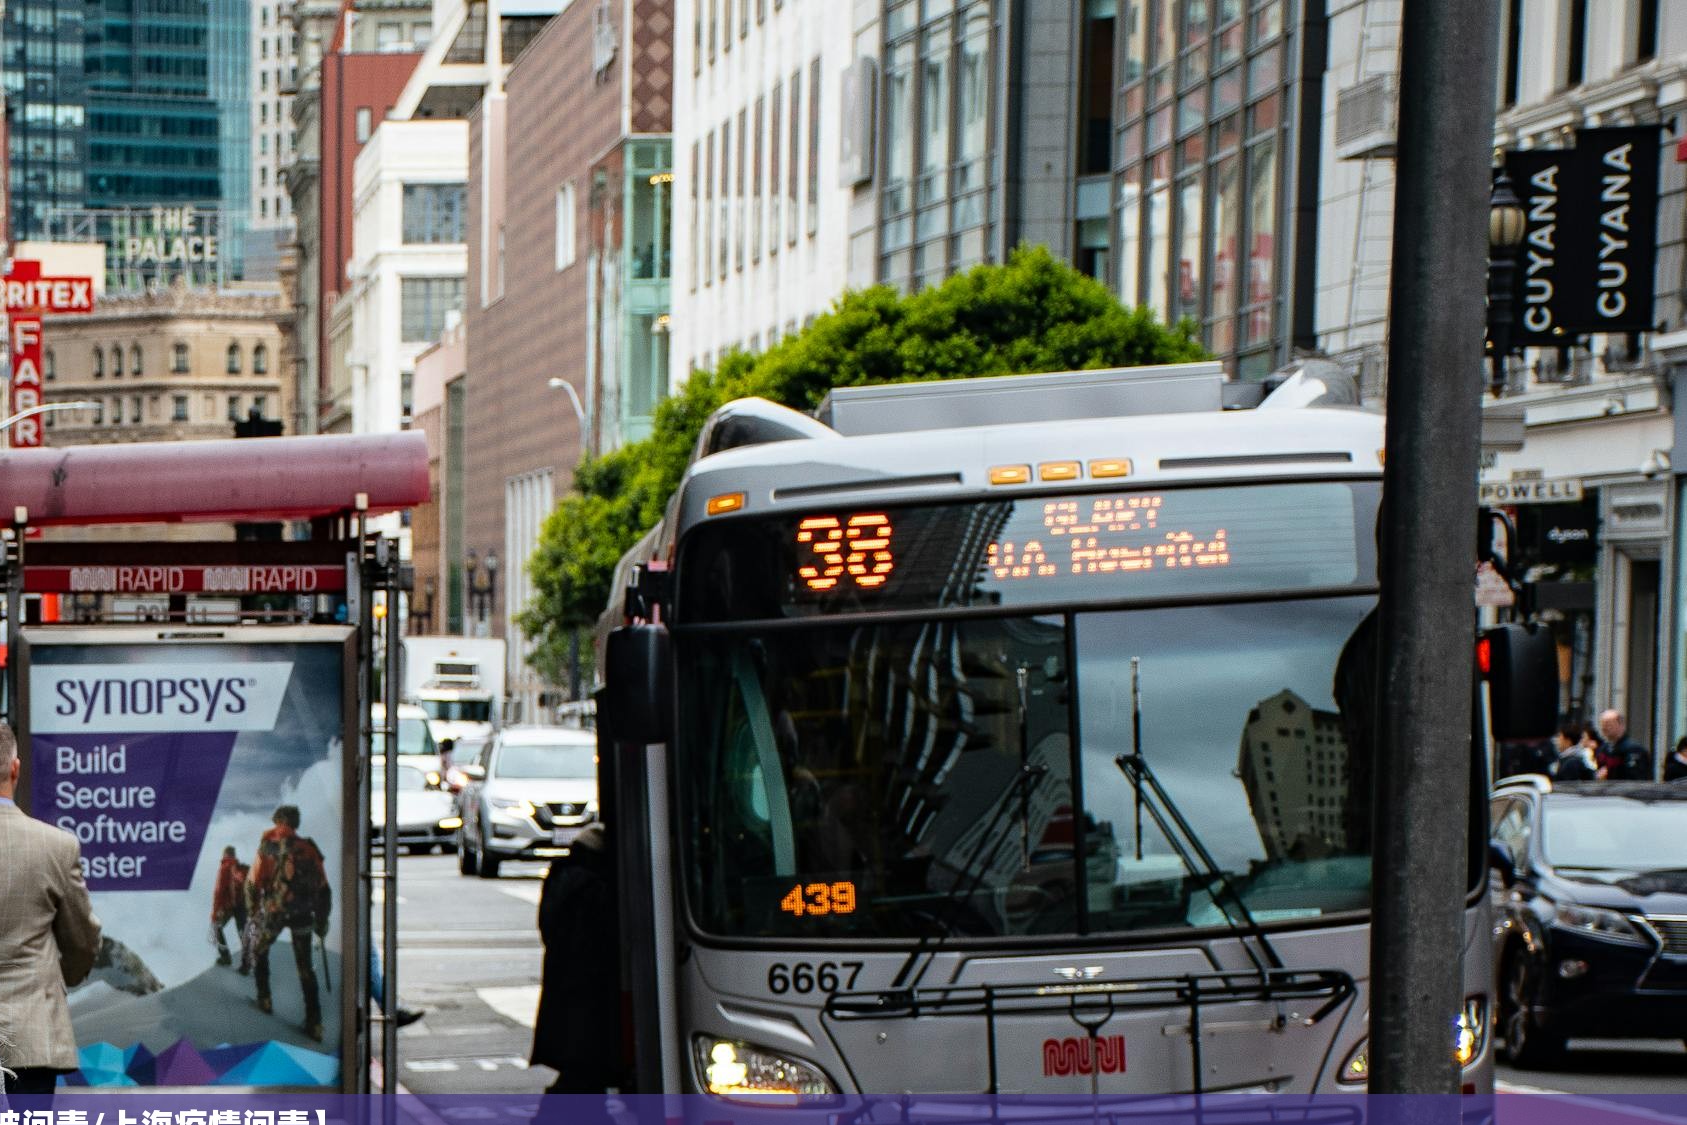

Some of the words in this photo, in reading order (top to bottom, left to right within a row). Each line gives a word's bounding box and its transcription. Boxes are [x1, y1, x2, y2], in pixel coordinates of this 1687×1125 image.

[152, 207, 196, 232] THE
[1597, 143, 1632, 318] CUYANA
[127, 236, 218, 262] PALACE
[1524, 164, 1559, 332] CUYANA
[1480, 482, 1575, 498] POWELL
[798, 512, 893, 590] 38
[119, 567, 184, 591] RAPID
[252, 567, 318, 591] RAPID
[56, 745, 127, 775] Build
[56, 781, 156, 809] Secure
[56, 815, 186, 843] Software
[82, 852, 146, 878] aster
[781, 882, 856, 916] 439
[768, 961, 864, 994] 6667
